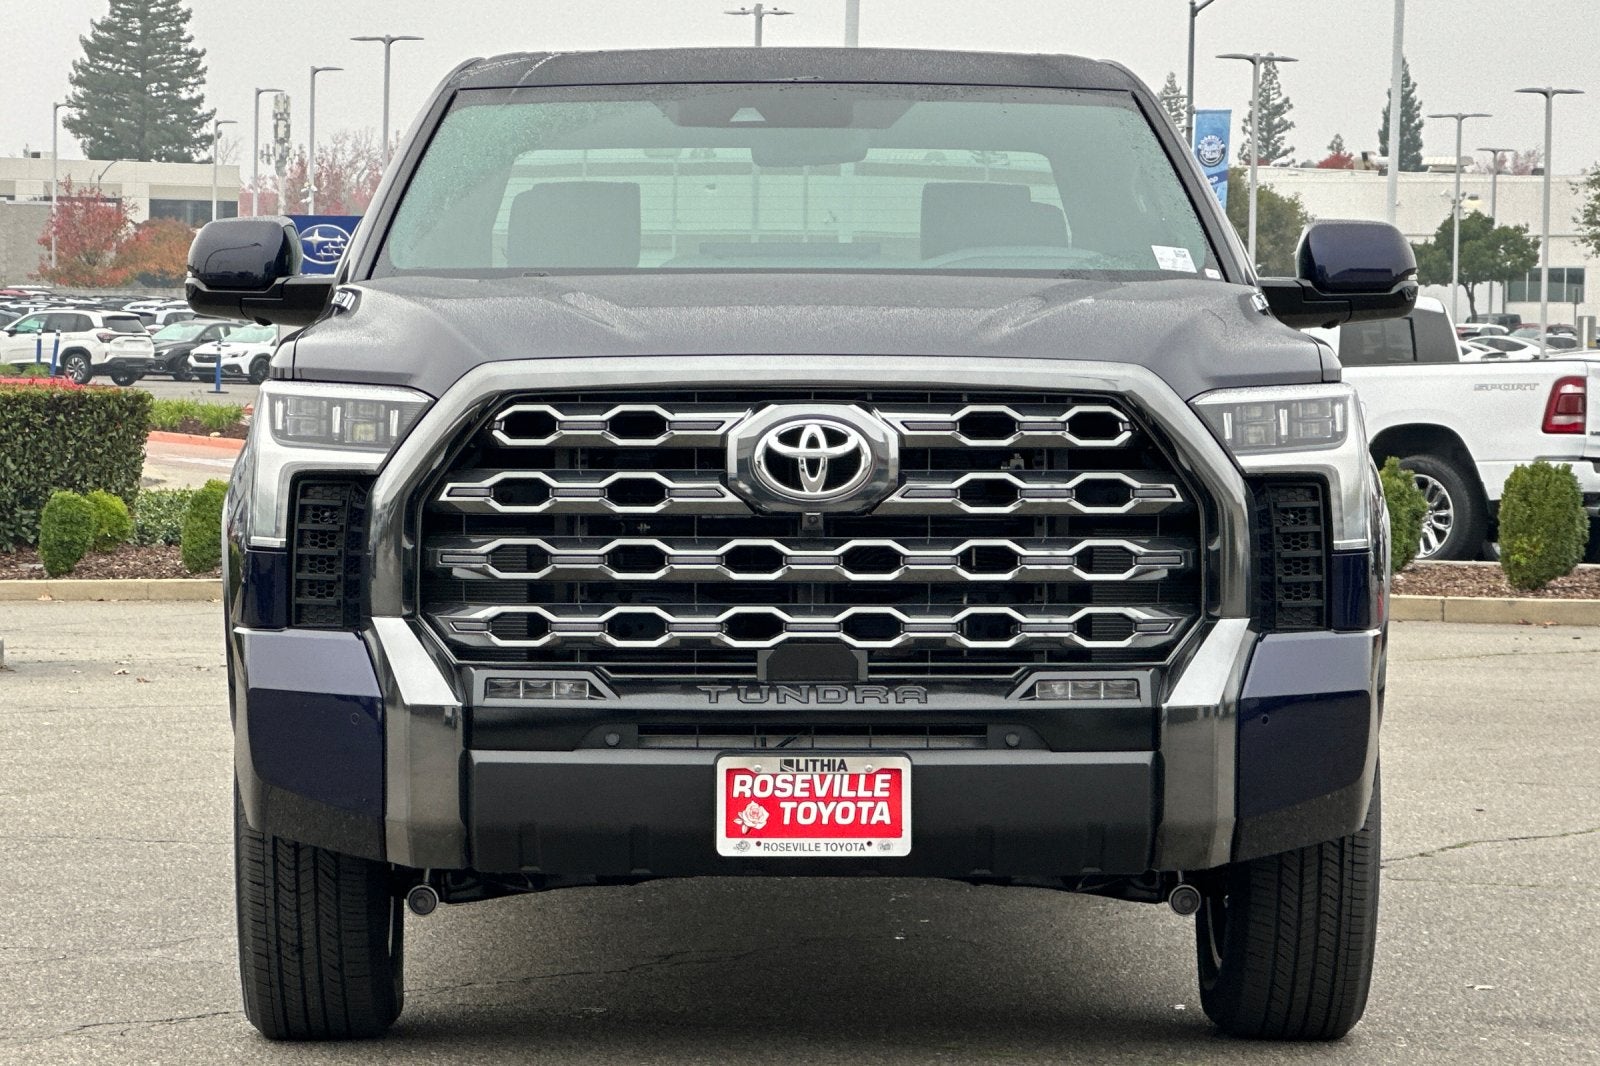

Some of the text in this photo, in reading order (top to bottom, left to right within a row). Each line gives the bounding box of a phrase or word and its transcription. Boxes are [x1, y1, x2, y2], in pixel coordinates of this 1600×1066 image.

[1474, 383, 1540, 391] SPORT
[696, 685, 928, 704] TUNDRA
[795, 759, 848, 772] LITHIA
[732, 774, 892, 798] ROSEVILLE
[779, 801, 891, 825] TOYOTA
[763, 843, 866, 852] ROSEVILLE TOYOTA
